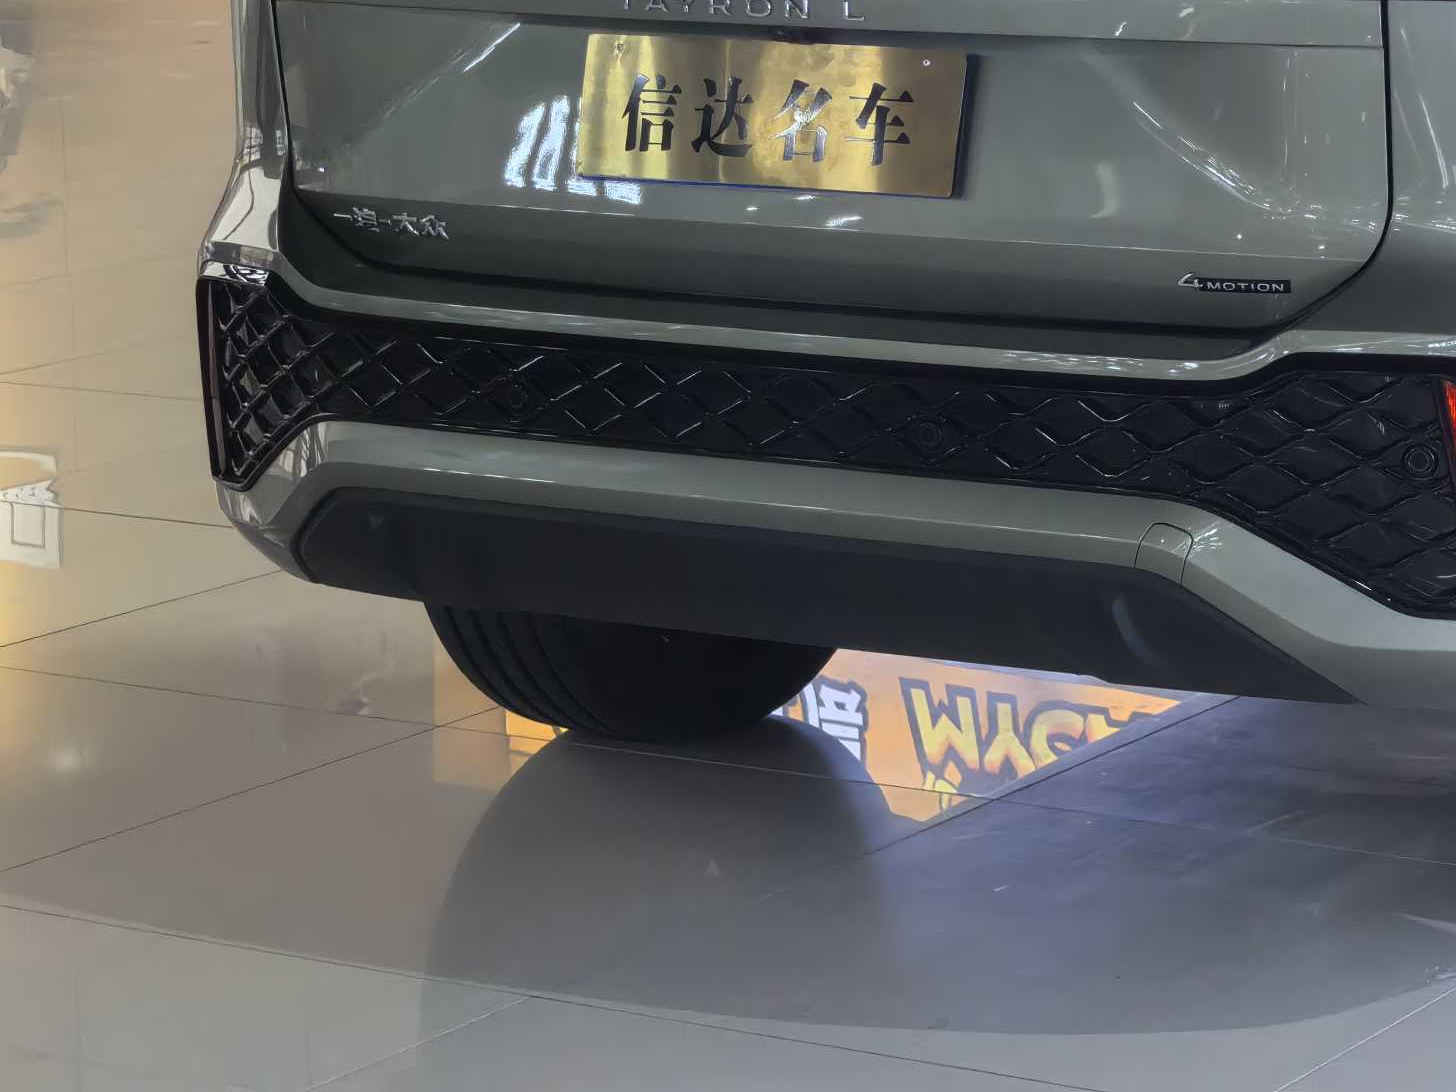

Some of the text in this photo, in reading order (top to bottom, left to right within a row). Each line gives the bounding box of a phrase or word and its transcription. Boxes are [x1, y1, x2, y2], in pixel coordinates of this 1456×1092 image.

[620, 74, 915, 167] 信达名车
[1177, 272, 1285, 292] 4MOTION
